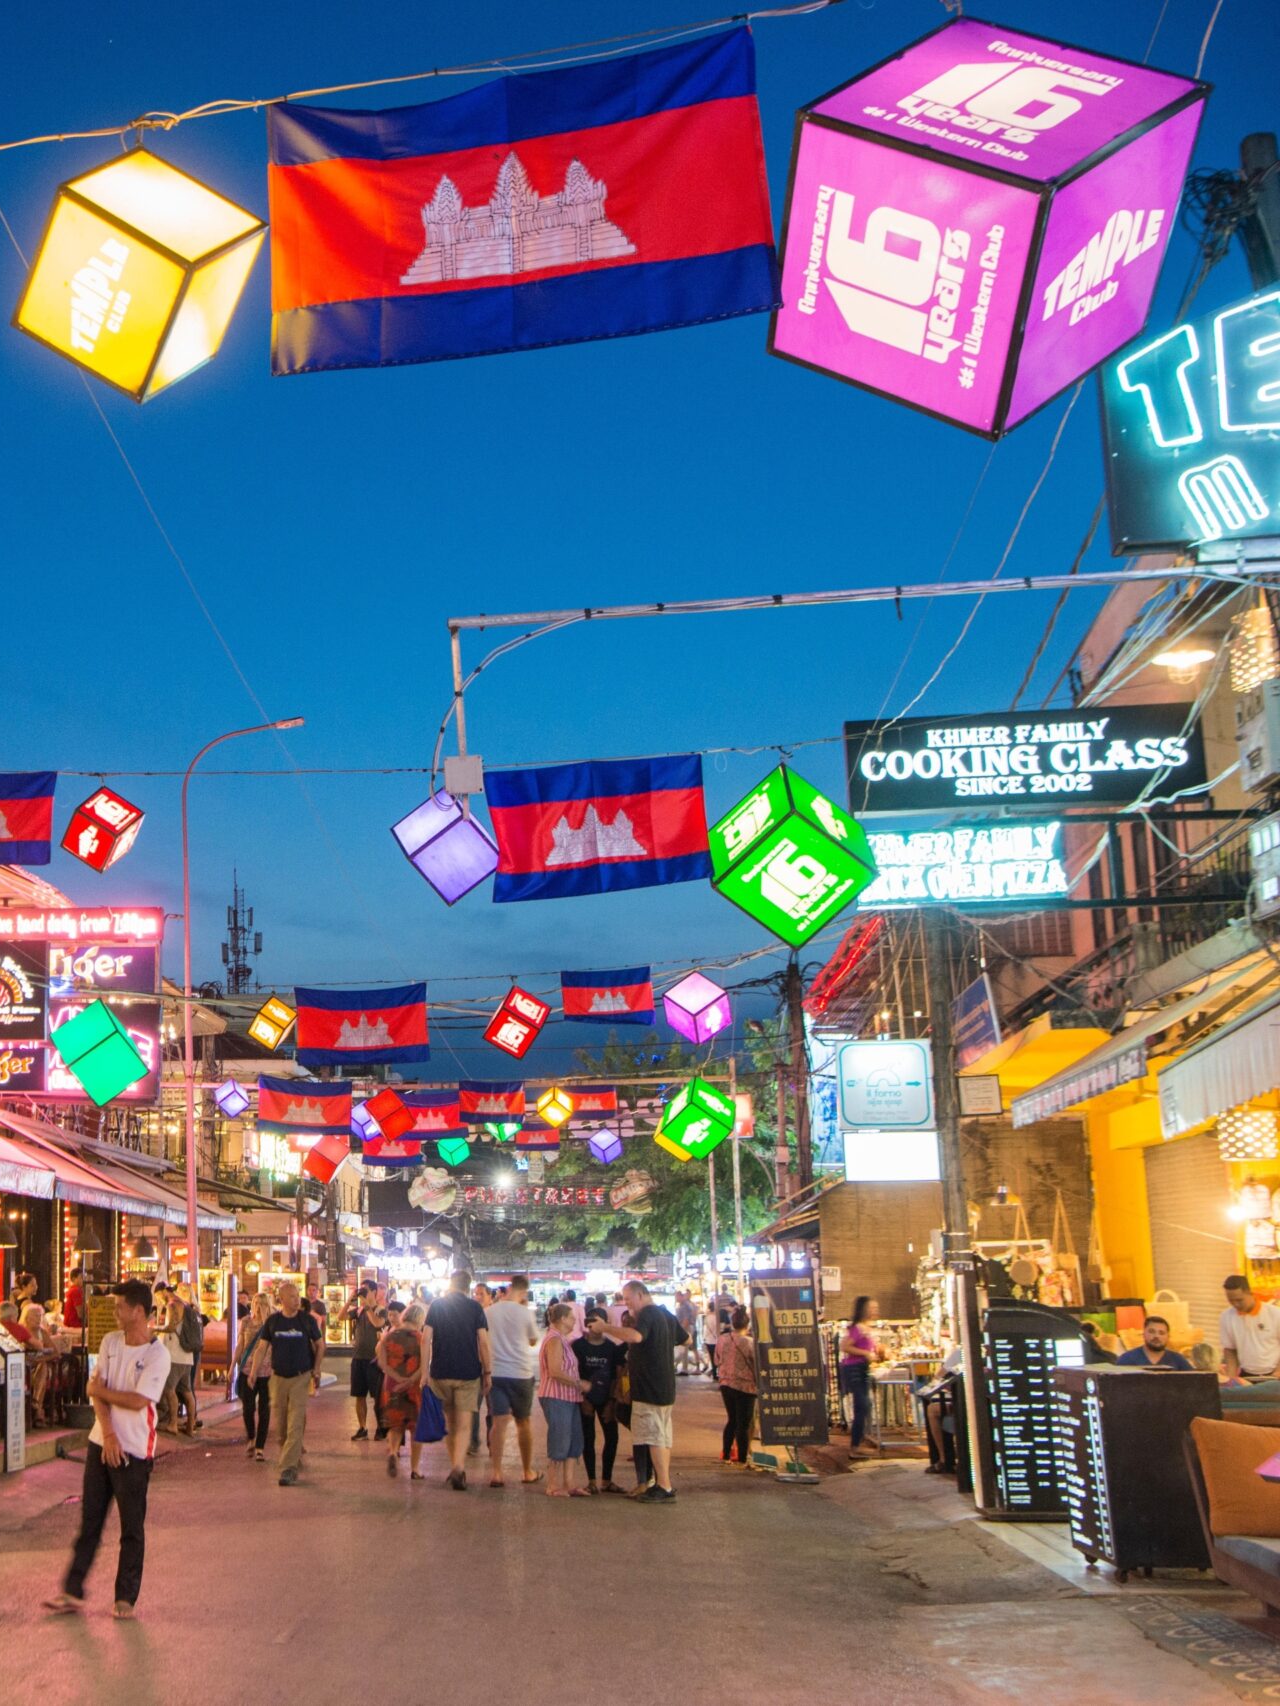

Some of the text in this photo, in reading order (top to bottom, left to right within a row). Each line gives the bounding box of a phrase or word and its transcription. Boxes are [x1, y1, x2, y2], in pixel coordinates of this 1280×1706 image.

[987, 40, 1124, 88] Anniversary
[914, 62, 1118, 131] 16
[896, 115, 980, 149] Western
[982, 138, 1030, 161] Club
[798, 184, 836, 314] Anniversary
[1042, 209, 1164, 321] TEMPLE
[823, 190, 942, 356] 16
[963, 269, 996, 354] Western
[980, 224, 1005, 270] Club
[70, 238, 130, 354] TEMPLE
[1069, 280, 1119, 327] Club
[926, 717, 1110, 748] KHMER FAMILY
[860, 736, 1189, 782] COOKING CLASS
[955, 772, 1093, 796] SINCE 2002
[952, 821, 1060, 863] FAMILY
[992, 859, 1070, 897] PIZZA
[49, 946, 134, 989] Tiger
[515, 1185, 606, 1206] STREET
[769, 1368, 819, 1379] LONG ISLAND
[770, 1378, 804, 1388] ICED TEA
[771, 1392, 817, 1401] MARGARITA
[772, 1406, 801, 1416] MOJITO
